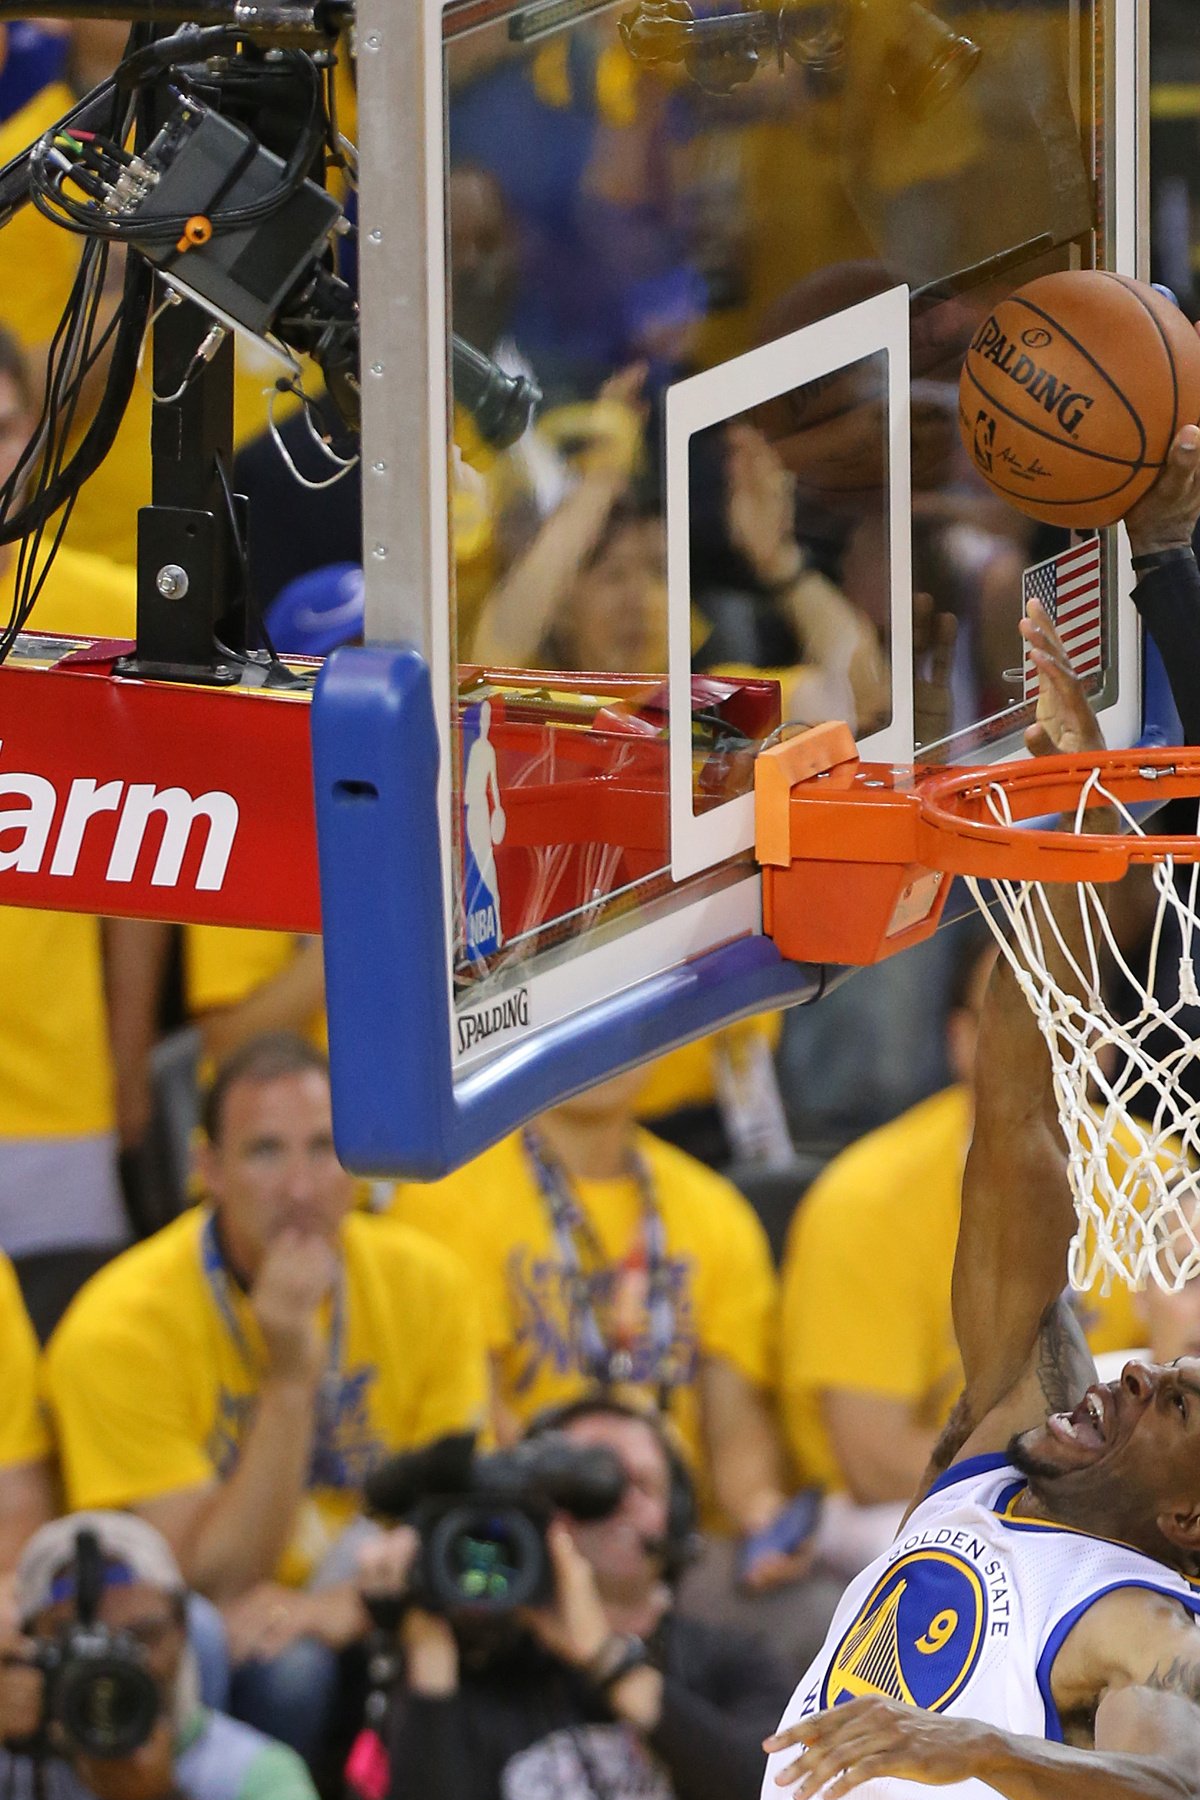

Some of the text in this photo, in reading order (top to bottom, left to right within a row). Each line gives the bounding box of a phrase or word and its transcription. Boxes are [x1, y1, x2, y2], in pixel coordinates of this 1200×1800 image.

[971, 315, 1094, 434] SPALDING
[0, 740, 240, 891] arm
[470, 904, 496, 944] NBA
[458, 986, 529, 1055] SPALDING
[889, 1528, 1012, 1637] GOLDEN STATE
[914, 1608, 959, 1655] 9
